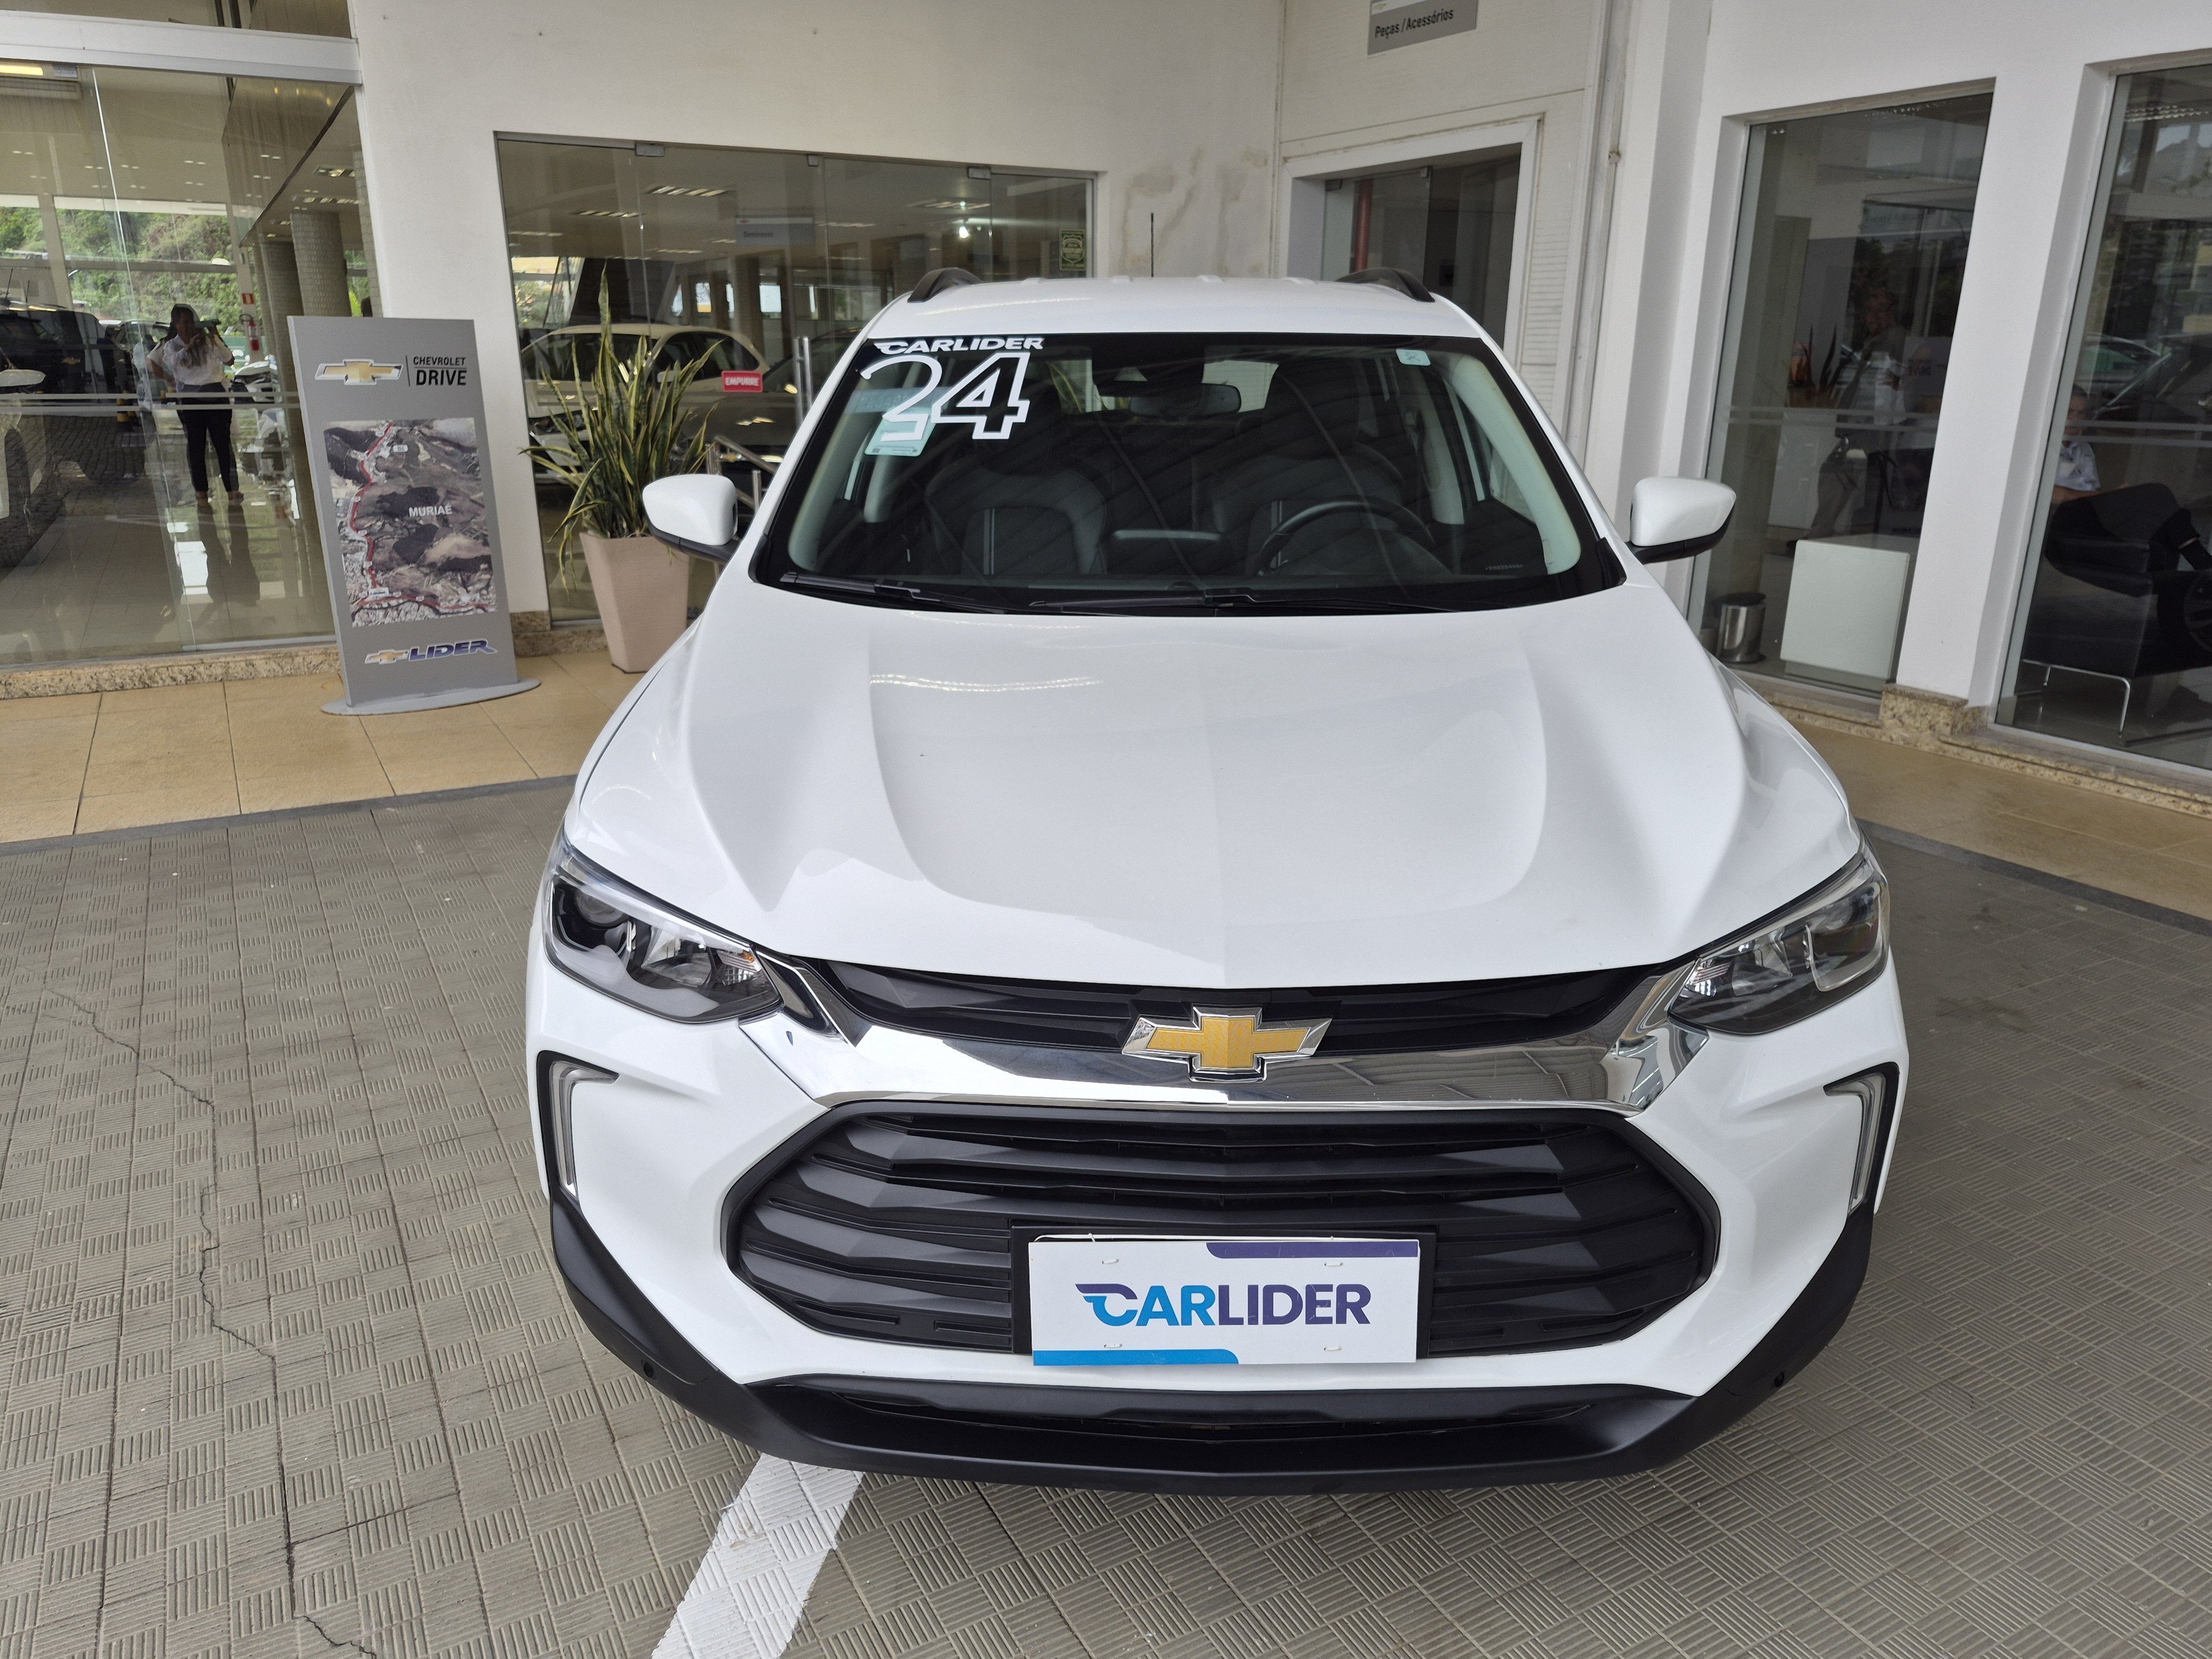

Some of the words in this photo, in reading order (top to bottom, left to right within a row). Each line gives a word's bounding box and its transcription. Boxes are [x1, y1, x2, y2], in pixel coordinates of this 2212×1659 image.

[873, 337, 1045, 354] CARLIDER
[413, 356, 466, 366] CHEVROLET
[416, 369, 467, 385] DRIVE
[725, 377, 760, 387] EMPURRE
[859, 352, 1031, 442] 24
[409, 502, 453, 517] MURIAÉ
[409, 638, 497, 661] LIDER
[1075, 1283, 1371, 1326] CARLIDER
